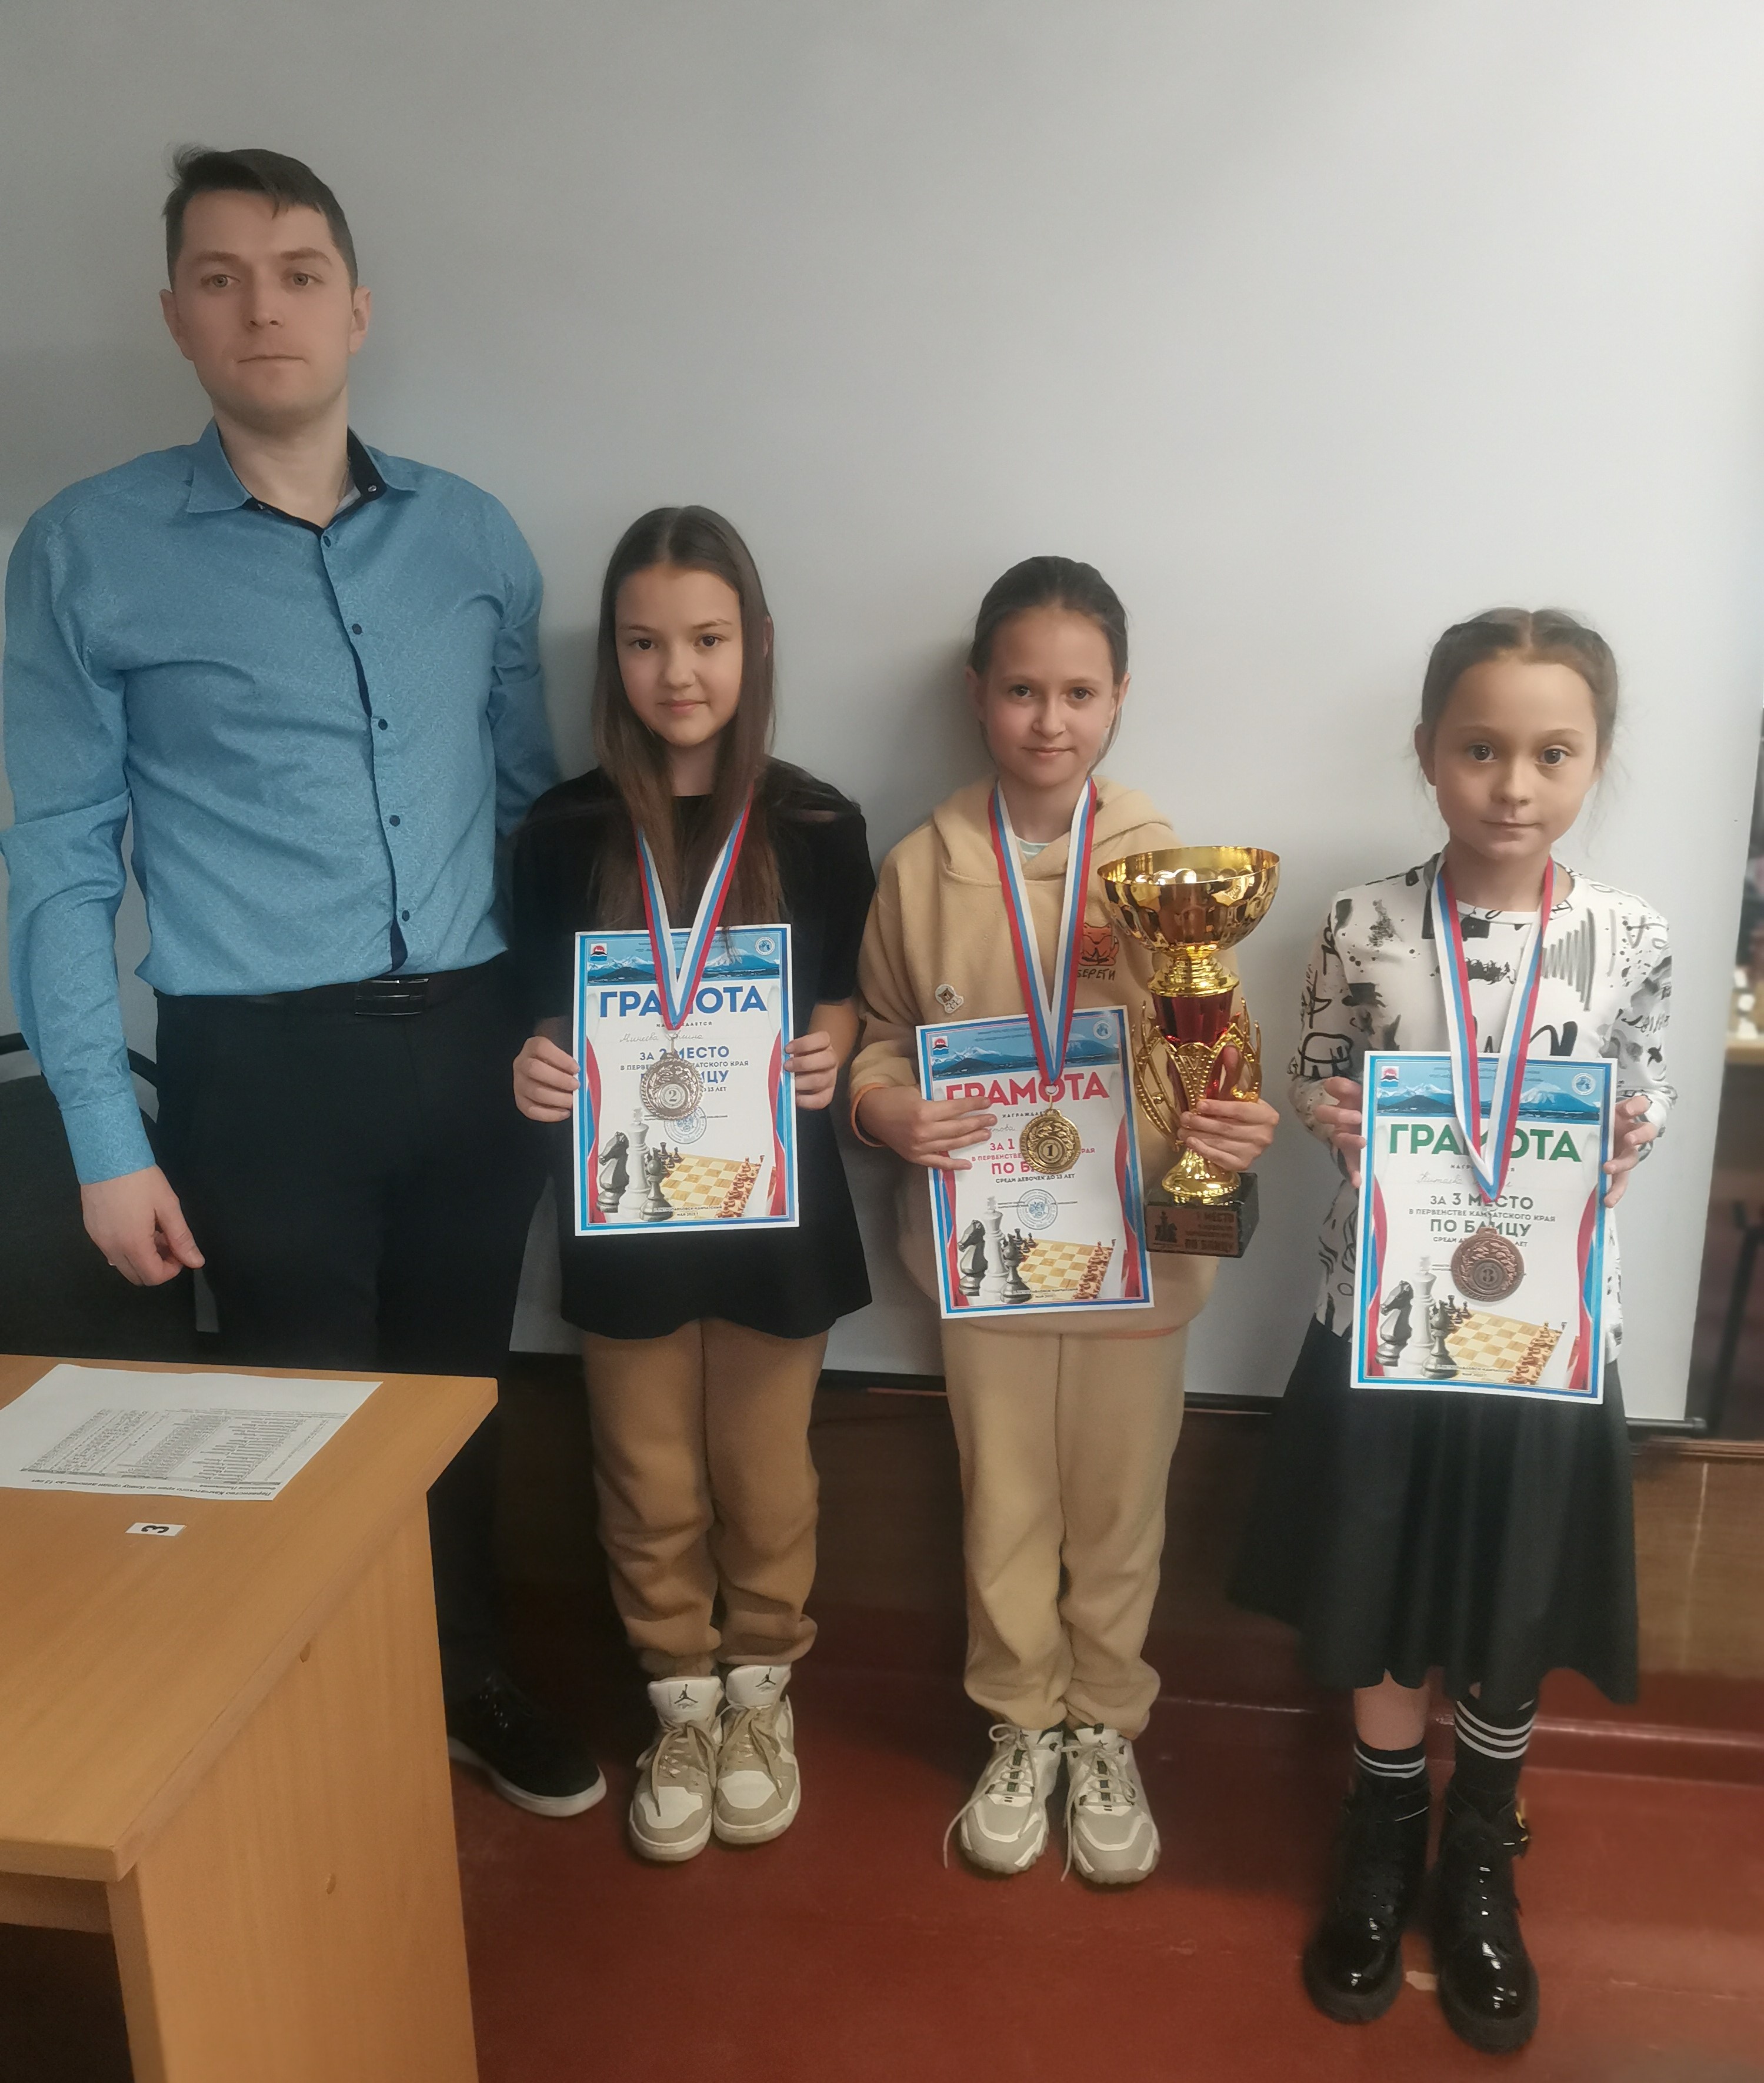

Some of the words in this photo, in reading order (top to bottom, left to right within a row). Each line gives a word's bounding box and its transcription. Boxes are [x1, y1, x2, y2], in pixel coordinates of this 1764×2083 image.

[600, 985, 768, 1018] ГРАОТА
[639, 1052, 655, 1060] ЗА
[669, 1089, 677, 1102] 2
[989, 1143, 1005, 1151] ЗА
[1008, 1138, 1015, 1150] 1
[1046, 1144, 1053, 1157] 1
[992, 1162, 1015, 1175] ПО
[1430, 1196, 1446, 1205] ЗА
[1452, 1193, 1461, 1206] 3
[1430, 1219, 1457, 1233] ПО
[141, 1525, 169, 1534] 3
